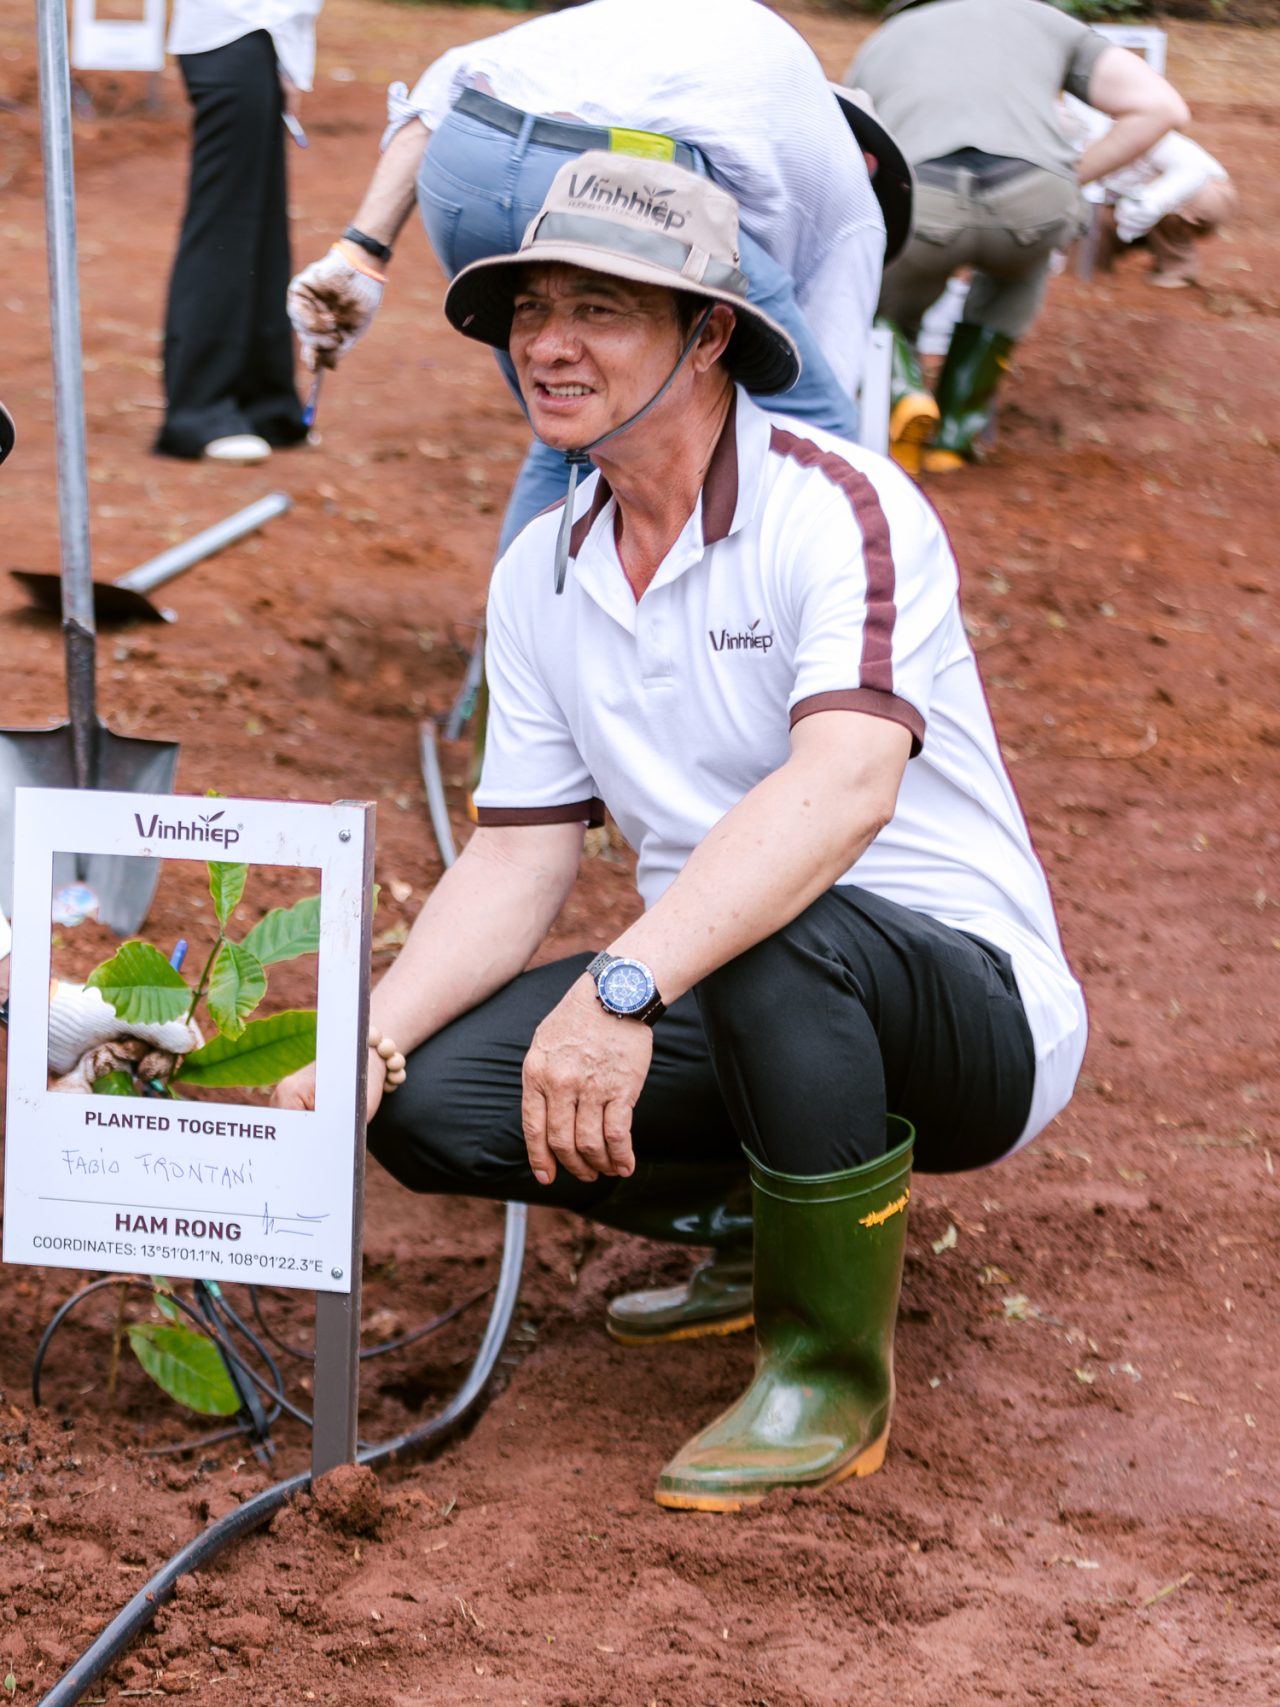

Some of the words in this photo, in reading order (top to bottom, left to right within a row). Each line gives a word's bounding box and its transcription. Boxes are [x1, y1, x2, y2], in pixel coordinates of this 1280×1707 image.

[84, 1111, 170, 1131] PLANTED
[177, 1118, 277, 1140] TOGETHER
[115, 1213, 168, 1236] HAM
[175, 1218, 242, 1241] RONG
[32, 1235, 137, 1256] COORDINATES:
